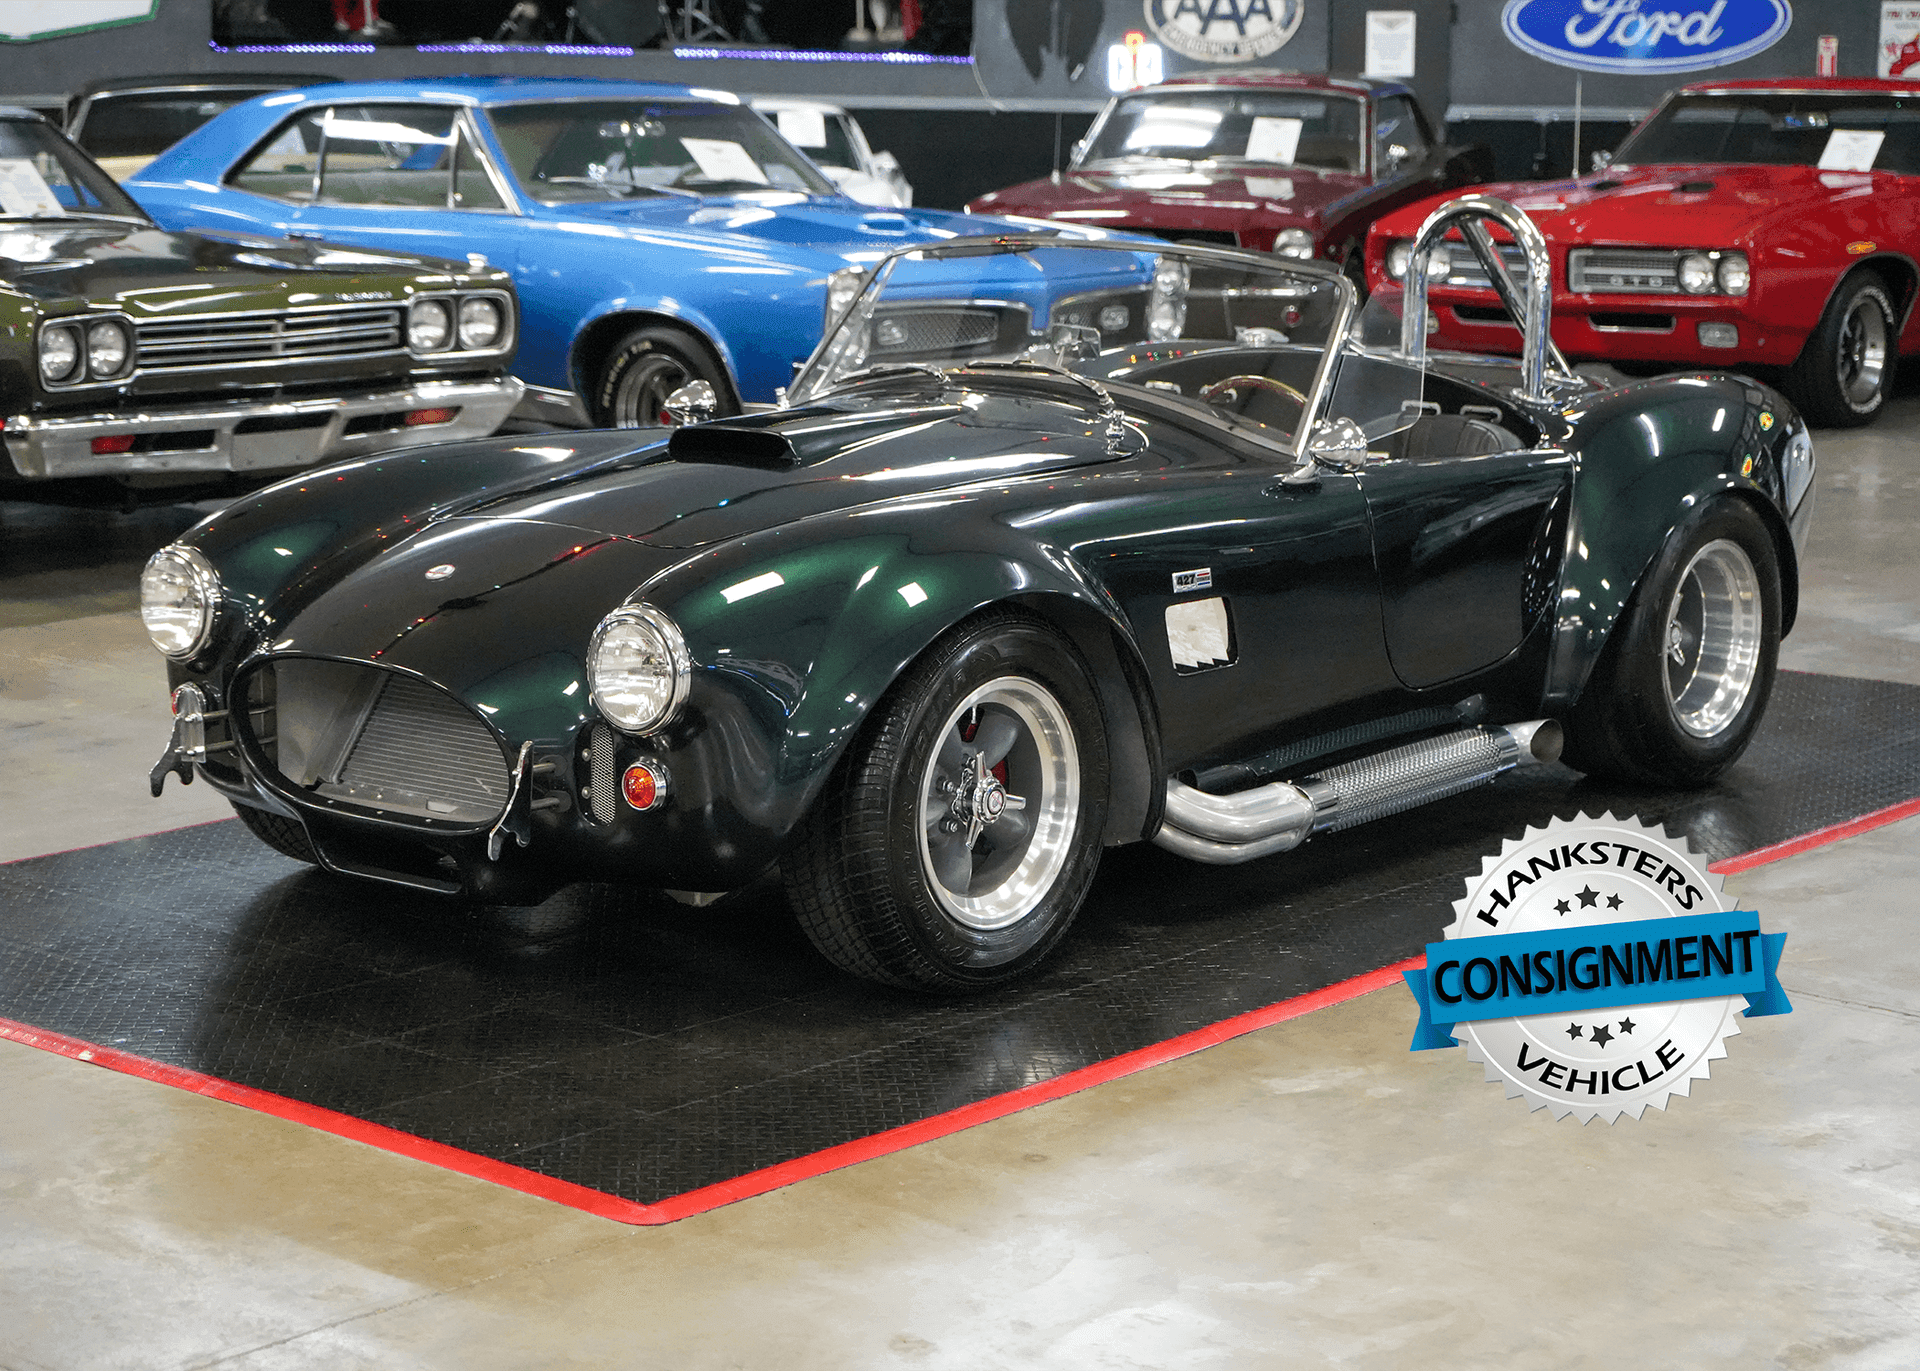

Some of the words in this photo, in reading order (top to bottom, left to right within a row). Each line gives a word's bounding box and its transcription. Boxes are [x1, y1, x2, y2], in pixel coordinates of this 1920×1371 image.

[1174, 0, 1272, 35] AAA
[1565, 0, 1727, 47] Ford
[1176, 573, 1196, 586] 427
